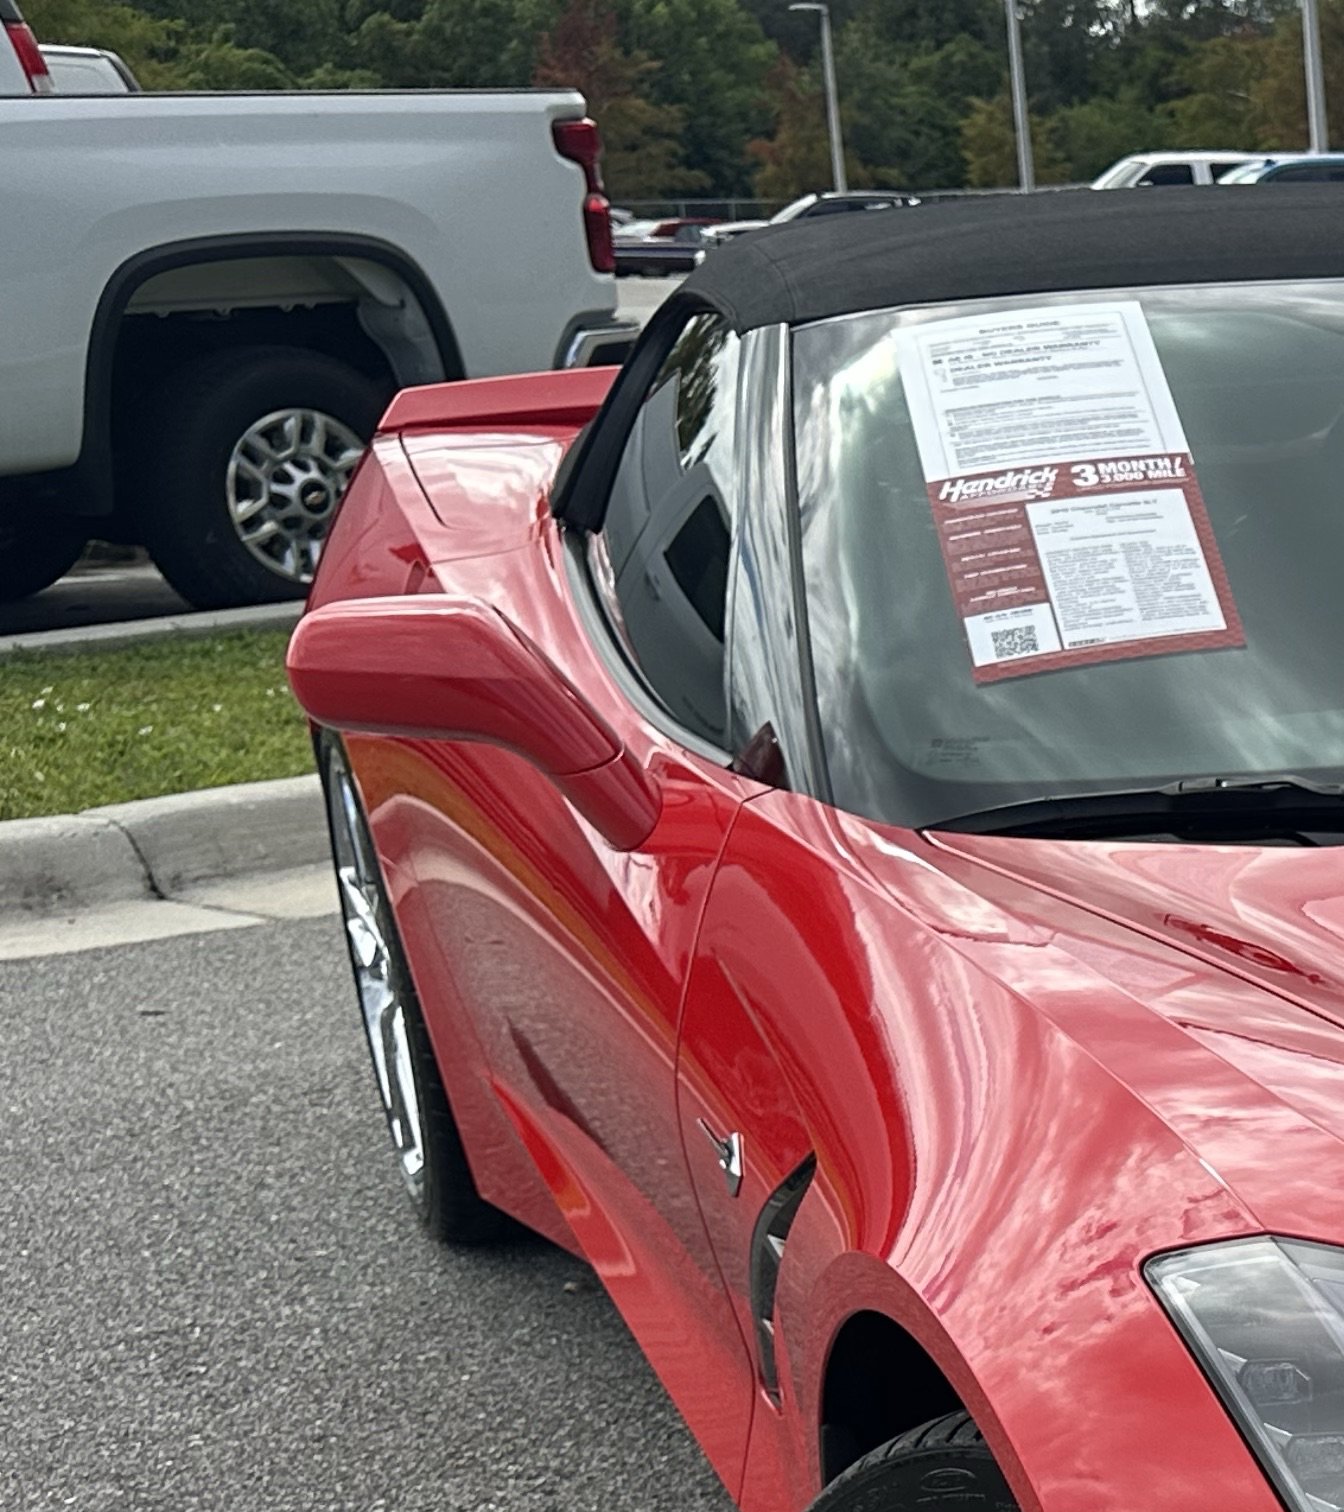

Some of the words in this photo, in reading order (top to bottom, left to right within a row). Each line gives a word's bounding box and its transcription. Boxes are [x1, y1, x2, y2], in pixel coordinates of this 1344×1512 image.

[938, 466, 1059, 502] Hendrick
[1070, 463, 1099, 487] 3
[1147, 467, 1187, 479] MILE
